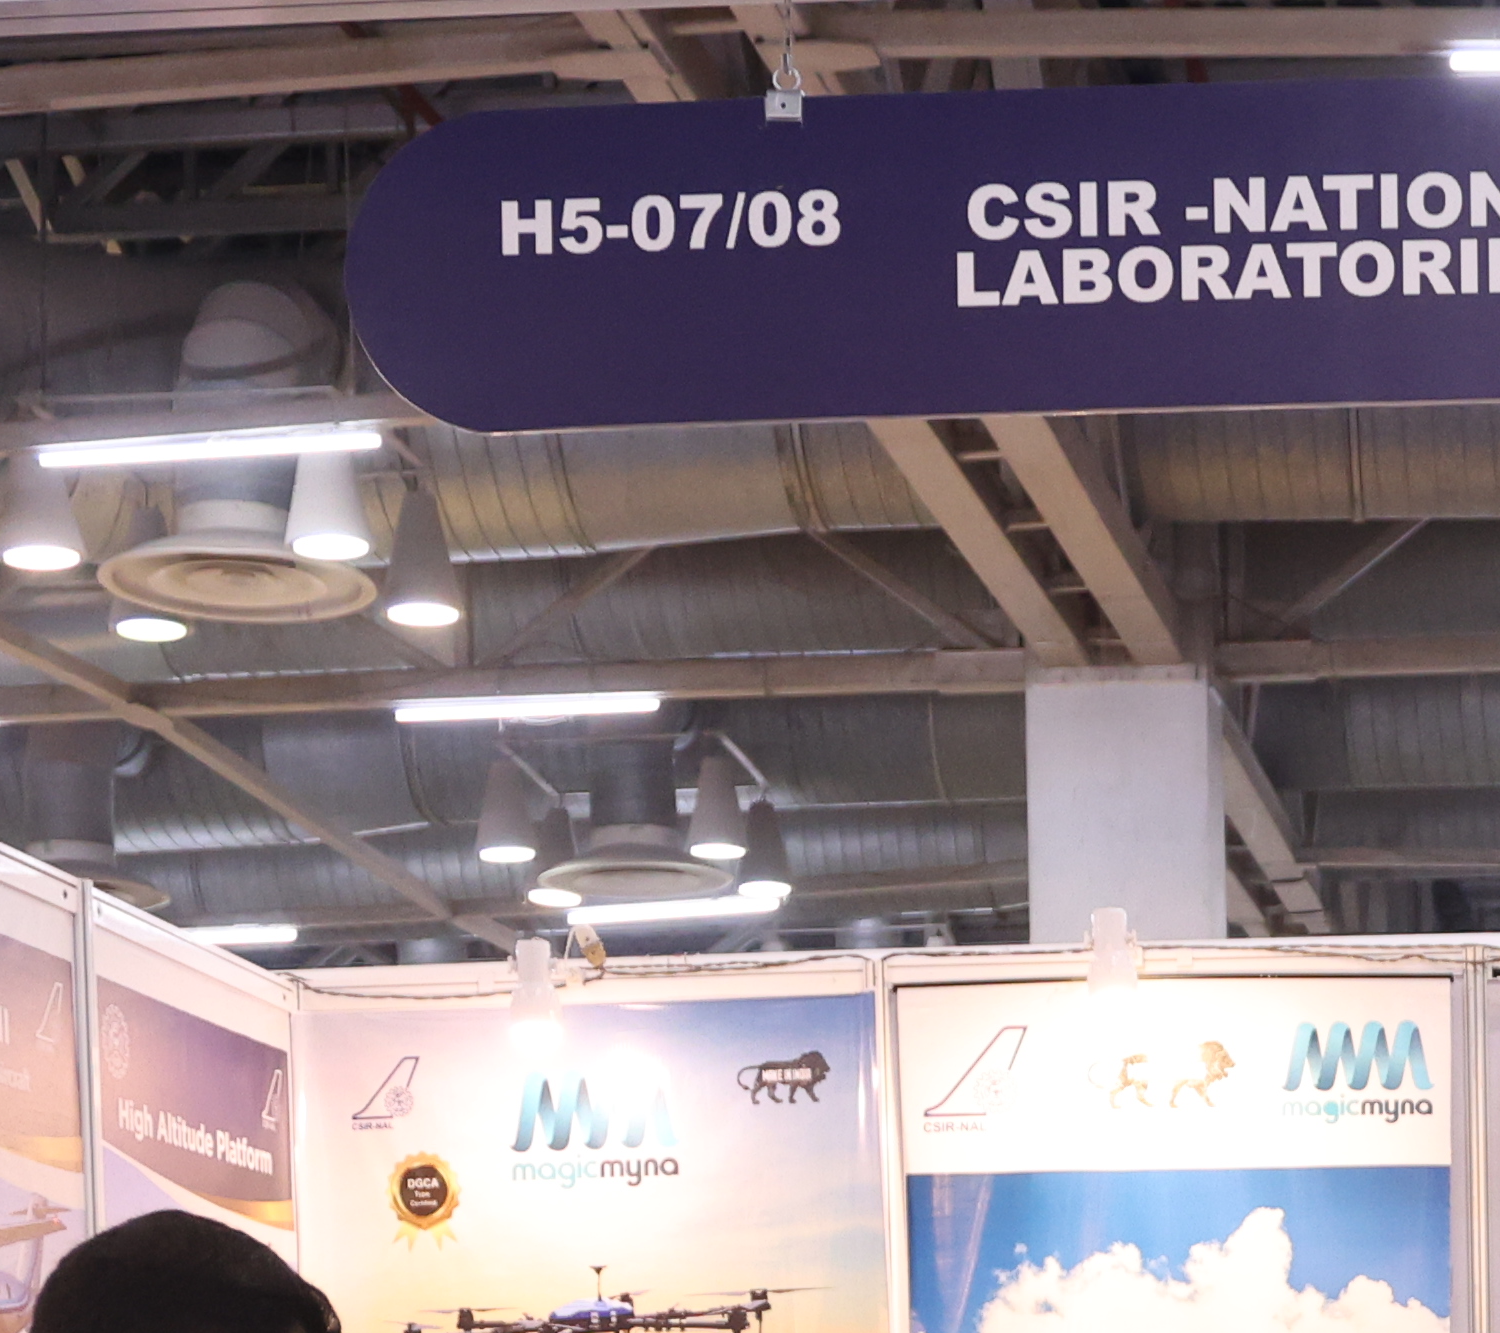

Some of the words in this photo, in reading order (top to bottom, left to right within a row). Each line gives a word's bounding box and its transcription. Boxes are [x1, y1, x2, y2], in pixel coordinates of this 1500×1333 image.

[501, 188, 842, 257] H5-07/08
[967, 180, 1158, 241] CSIR
[1282, 1094, 1435, 1124] magicmyna
[117, 1097, 154, 1142] High
[157, 1109, 214, 1161] Altitude
[215, 1123, 274, 1176] Platform
[406, 1177, 440, 1190] DGCA
[511, 1155, 680, 1189] magicmyna
